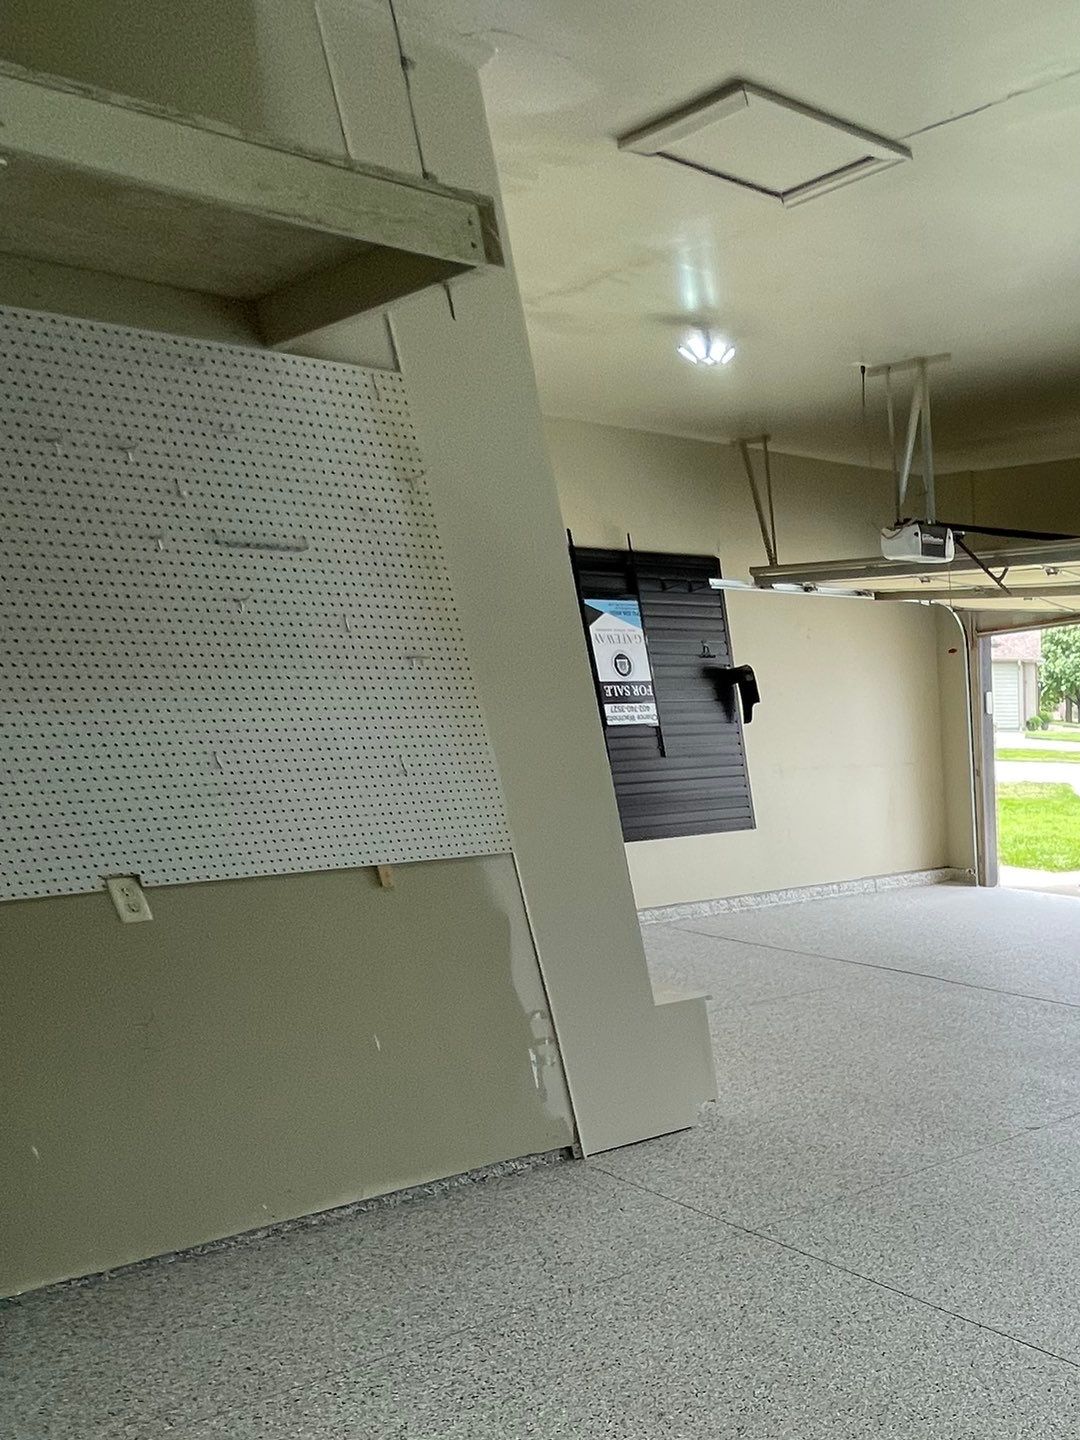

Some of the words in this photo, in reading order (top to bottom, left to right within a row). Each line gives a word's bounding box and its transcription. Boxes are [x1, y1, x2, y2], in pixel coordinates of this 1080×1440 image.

[594, 633, 642, 645] GATEWAY
[603, 684, 631, 697] SALE
[631, 684, 654, 697] FOR
